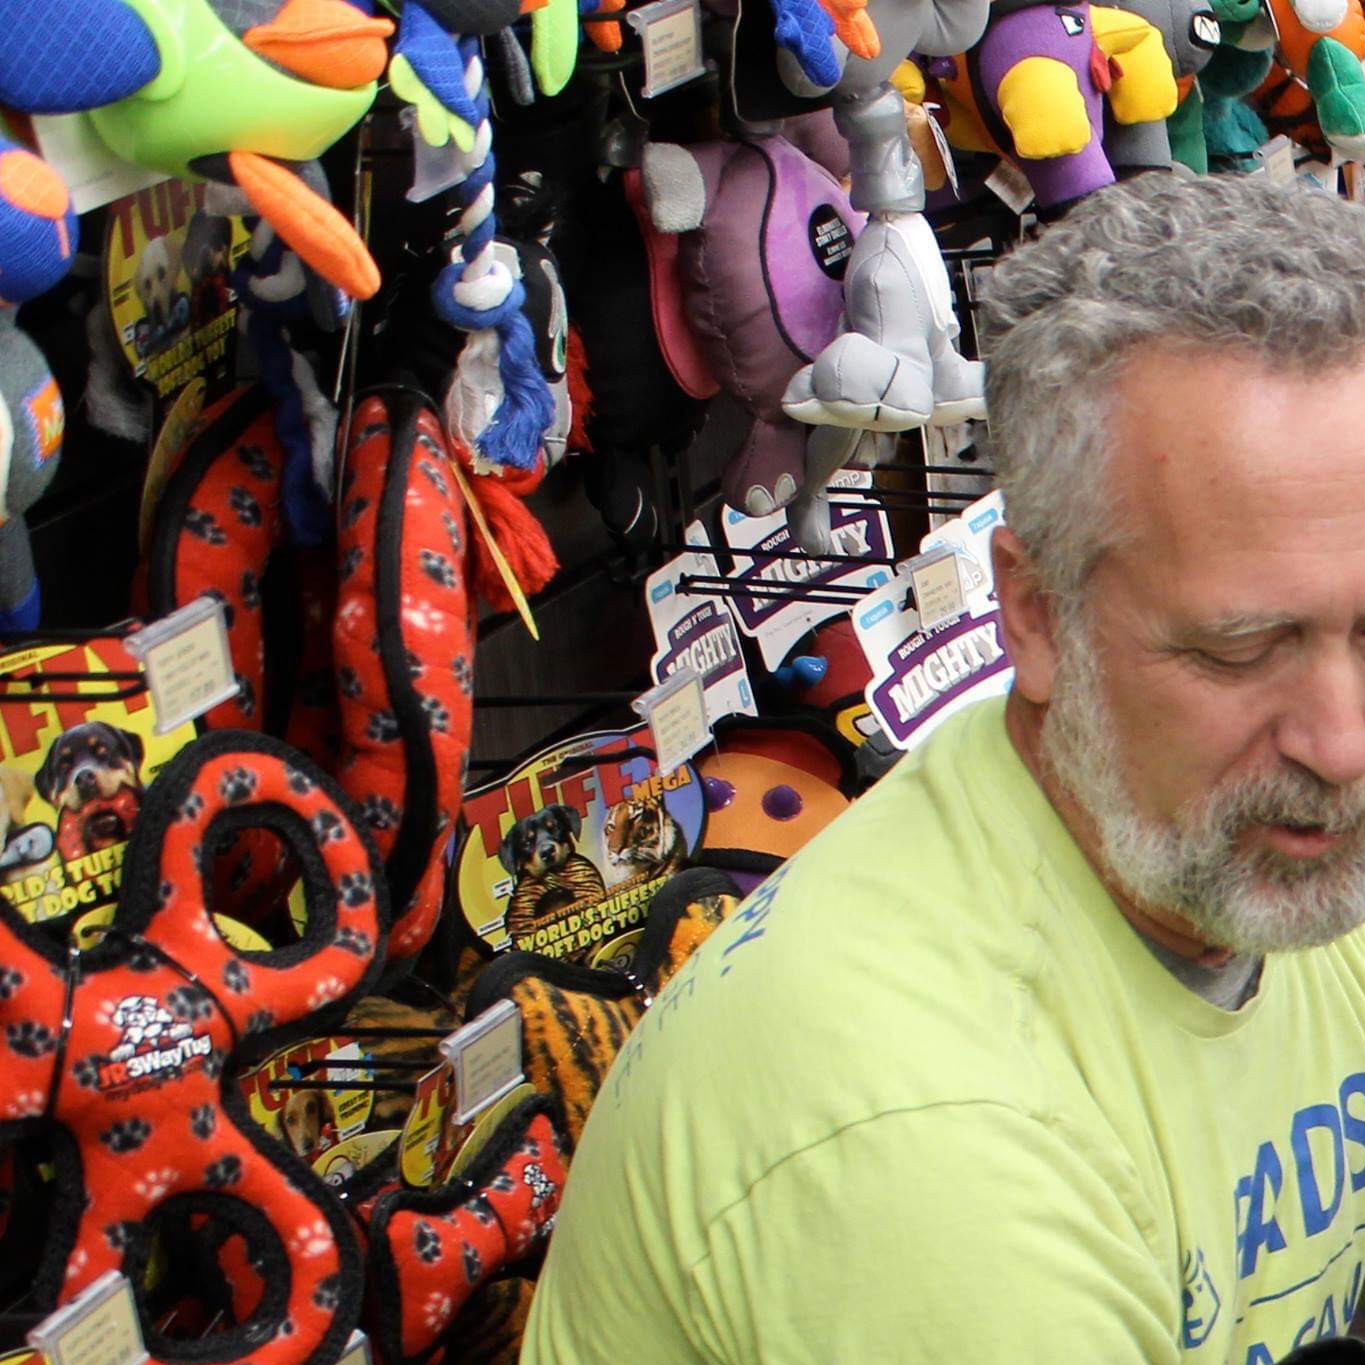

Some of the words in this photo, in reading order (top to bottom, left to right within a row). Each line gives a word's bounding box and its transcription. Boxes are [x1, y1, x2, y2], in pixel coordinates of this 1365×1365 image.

[761, 529, 791, 550] ROUGH
[897, 633, 927, 660] ROUGH
[888, 620, 1004, 725] MIGHTY
[630, 766, 693, 800] MEGA
[43, 881, 97, 917] DOG
[516, 906, 597, 953] WORLD'S
[577, 918, 615, 948] DOG
